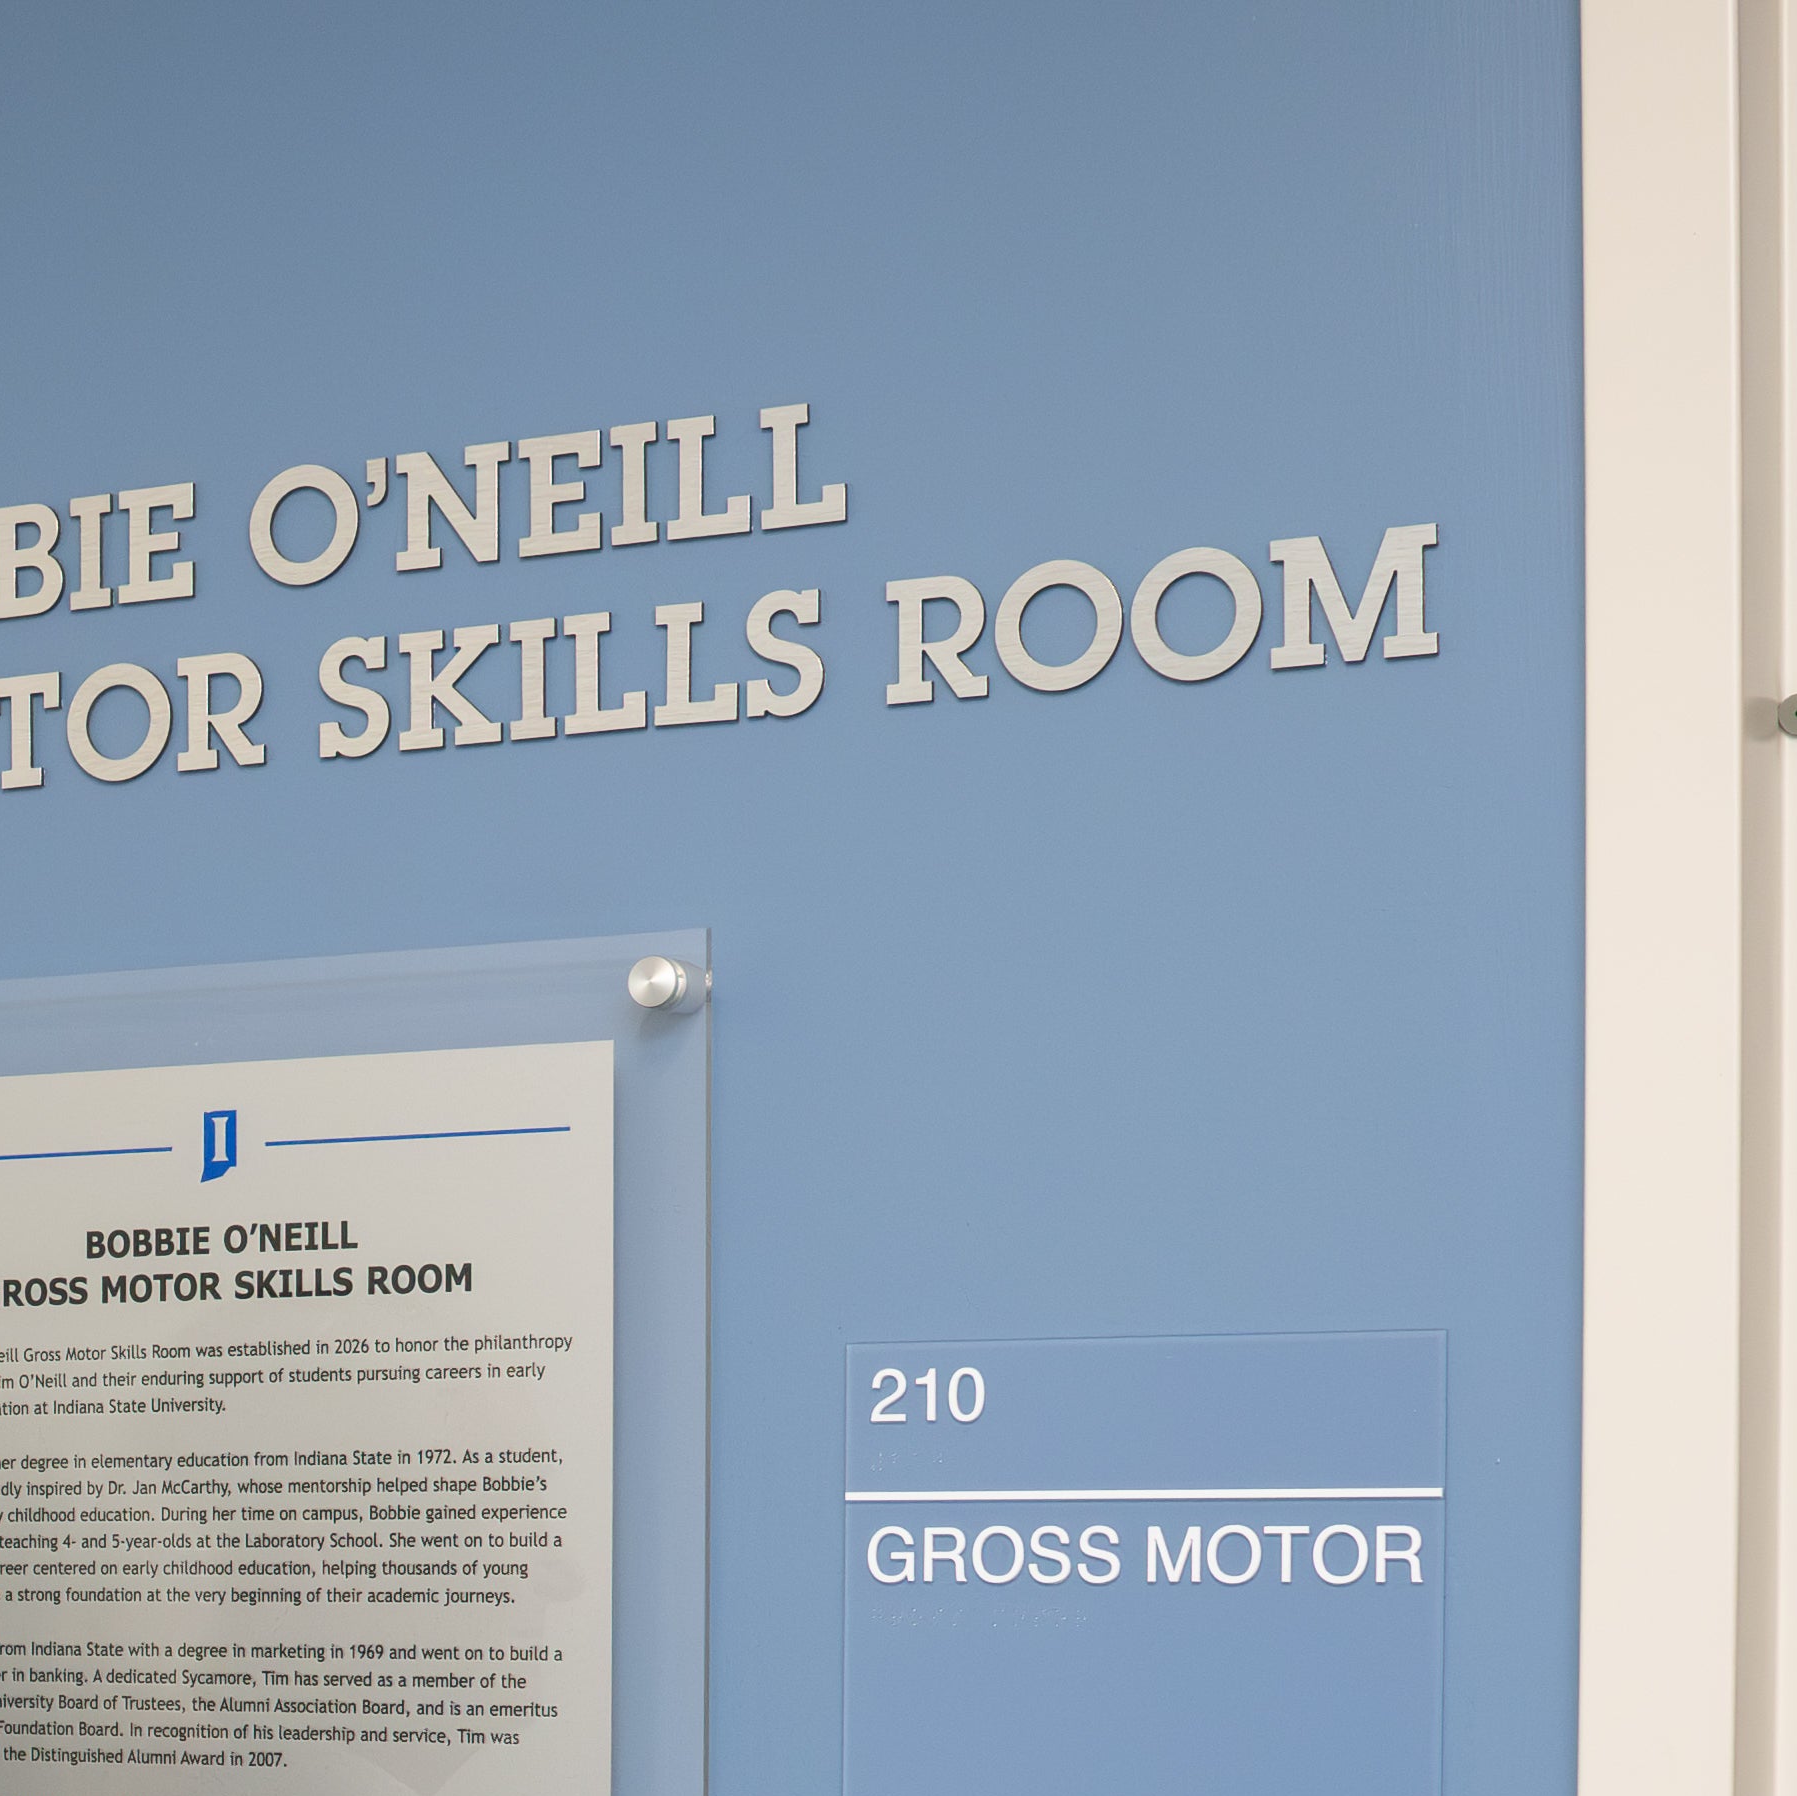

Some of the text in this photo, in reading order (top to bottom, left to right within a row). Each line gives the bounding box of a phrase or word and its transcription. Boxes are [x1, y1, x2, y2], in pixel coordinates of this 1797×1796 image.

[249, 403, 845, 585] O’NEILL
[319, 589, 823, 758] SKILLS
[886, 523, 1438, 704] ROOM
[86, 1220, 358, 1259] BOBBIE O’NEILL
[101, 1271, 222, 1304] MOTOR
[234, 1266, 353, 1300] SKILLS
[367, 1262, 472, 1295] ROOM
[23, 1347, 62, 1362] Gross
[65, 1346, 107, 1361] Motor
[110, 1343, 147, 1360] Skills
[151, 1343, 190, 1359] Room
[195, 1345, 223, 1358] was
[227, 1338, 311, 1357] established
[315, 1339, 329, 1355] in
[334, 1338, 370, 1354] 2026
[374, 1339, 390, 1353] to
[395, 1337, 439, 1353] honor
[443, 1335, 470, 1352] the
[474, 1333, 573, 1354] philanthropy
[18, 1372, 68, 1389] O’Neill
[71, 1371, 97, 1388] and
[101, 1371, 137, 1387] their
[141, 1370, 205, 1389] enduring
[208, 1369, 264, 1388] support
[268, 1367, 285, 1383] of
[288, 1366, 352, 1383] students
[356, 1364, 421, 1385] pursuing
[425, 1366, 482, 1380] careers
[487, 1362, 501, 1378] in
[506, 1361, 546, 1381] early
[33, 1400, 49, 1415] at
[53, 1399, 104, 1415] Indiana
[108, 1398, 146, 1414] State
[150, 1396, 226, 1415] University.
[871, 1367, 984, 1421] 210
[20, 1454, 69, 1473] degree
[73, 1454, 87, 1469] in
[90, 1453, 173, 1471] elementary
[177, 1451, 249, 1468] education
[253, 1451, 289, 1467] from
[293, 1449, 348, 1466] Indiana
[352, 1449, 392, 1466] State
[396, 1449, 411, 1465] in
[417, 1448, 457, 1464] 1972.
[461, 1448, 480, 1464] As
[484, 1451, 494, 1464] a
[498, 1447, 563, 1465] student,
[7, 1506, 76, 1523] childhood
[79, 1506, 155, 1522] education.
[161, 1506, 208, 1525] During
[212, 1505, 237, 1521] her
[240, 1506, 275, 1521] time
[279, 1508, 297, 1521] on
[302, 1508, 363, 1524] campus,
[369, 1503, 421, 1521] Bobbie
[425, 1503, 476, 1524] gained
[480, 1503, 568, 1523] experience
[868, 1525, 1422, 1583] GROSS MOTOR
[32, 1559, 96, 1576] centered
[100, 1563, 118, 1576] on
[121, 1559, 159, 1579] early
[162, 1559, 233, 1576] childhood
[237, 1559, 316, 1578] education,
[322, 1559, 377, 1579] helping
[381, 1559, 458, 1575] thousands
[462, 1559, 479, 1575] of
[482, 1563, 529, 1579] young
[58, 1693, 99, 1710] Board
[102, 1694, 119, 1710] of
[121, 1695, 186, 1714] Trustees,
[191, 1695, 217, 1712] the
[219, 1695, 270, 1713] Alumni
[273, 1697, 357, 1714] Association
[362, 1698, 411, 1718] Board,
[416, 1699, 444, 1716] and
[449, 1700, 462, 1716] is
[465, 1704, 485, 1716] an
[489, 1701, 558, 1718] emeritus
[3, 1744, 27, 1762] the
[30, 1746, 124, 1766] Distinguished
[126, 1748, 177, 1765] Alumni
[179, 1749, 228, 1766] Award
[229, 1751, 244, 1767] in
[247, 1751, 287, 1768] 2007.
